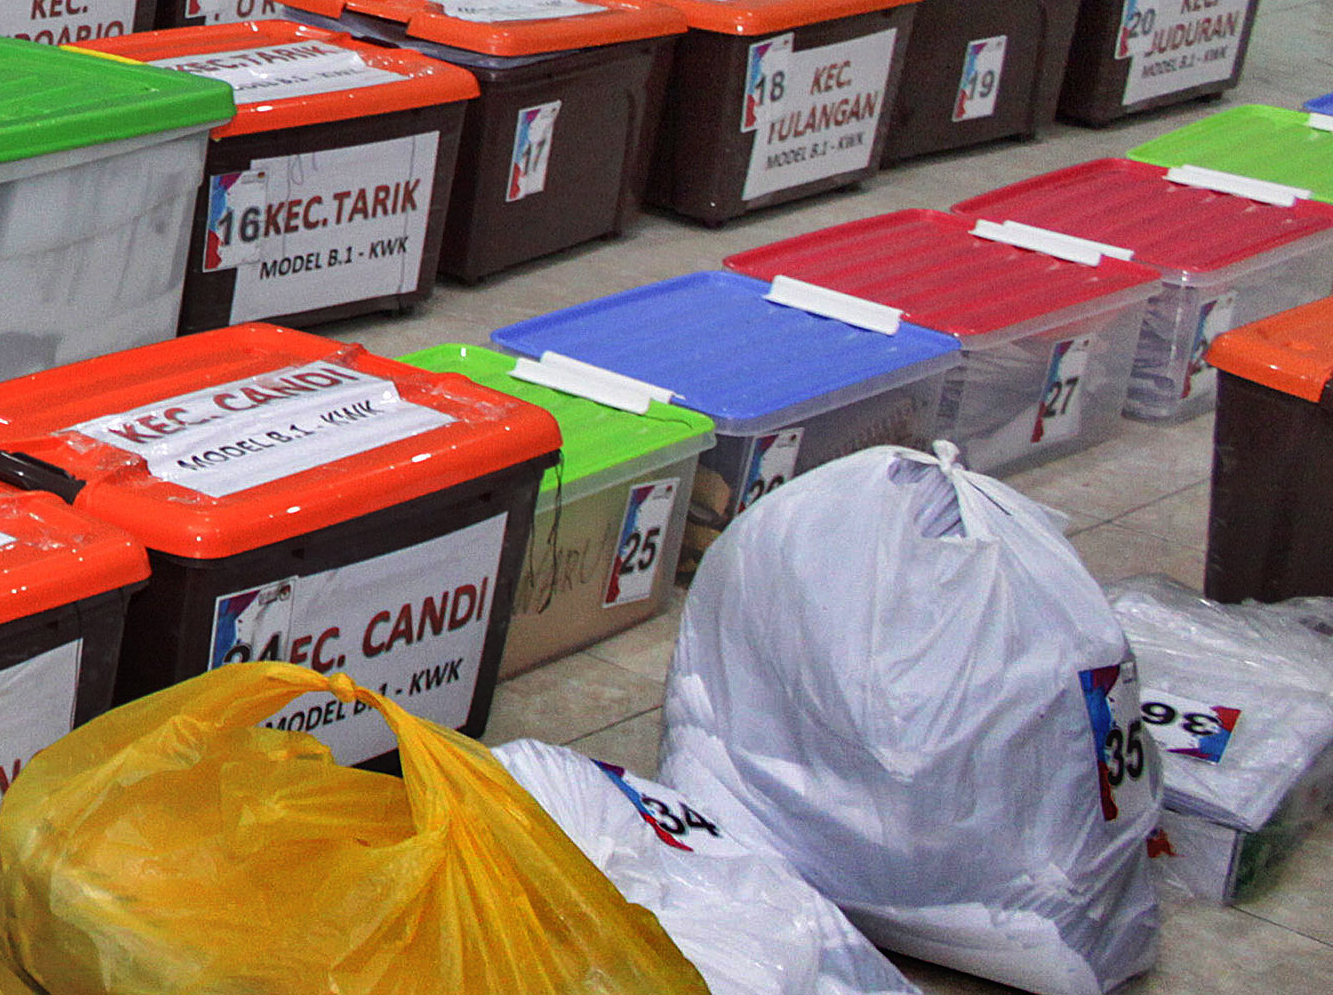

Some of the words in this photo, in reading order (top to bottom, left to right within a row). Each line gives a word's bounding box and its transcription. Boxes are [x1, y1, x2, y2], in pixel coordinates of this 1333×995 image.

[1128, 7, 1156, 39] 20
[754, 70, 785, 105] 18
[810, 60, 852, 96] KEC.
[965, 69, 995, 101] 19
[522, 138, 548, 177] 17
[765, 144, 807, 169] MODEL
[837, 130, 865, 152] KWK
[218, 206, 261, 248] 16
[263, 178, 421, 238] KEC.TARIK
[259, 254, 323, 281] MODEL
[328, 245, 354, 267] B.1
[369, 235, 409, 260] KWK
[108, 404, 219, 446] KEC.
[211, 367, 361, 414] CANDI
[1043, 374, 1079, 421] 27
[176, 437, 274, 474] MODEL
[319, 399, 385, 428] KWK
[617, 527, 661, 577] 25
[361, 576, 490, 659] CANDI
[408, 657, 464, 697] KWK
[1140, 700, 1223, 736] 36
[1105, 720, 1144, 786] 35
[643, 797, 721, 839] 34
